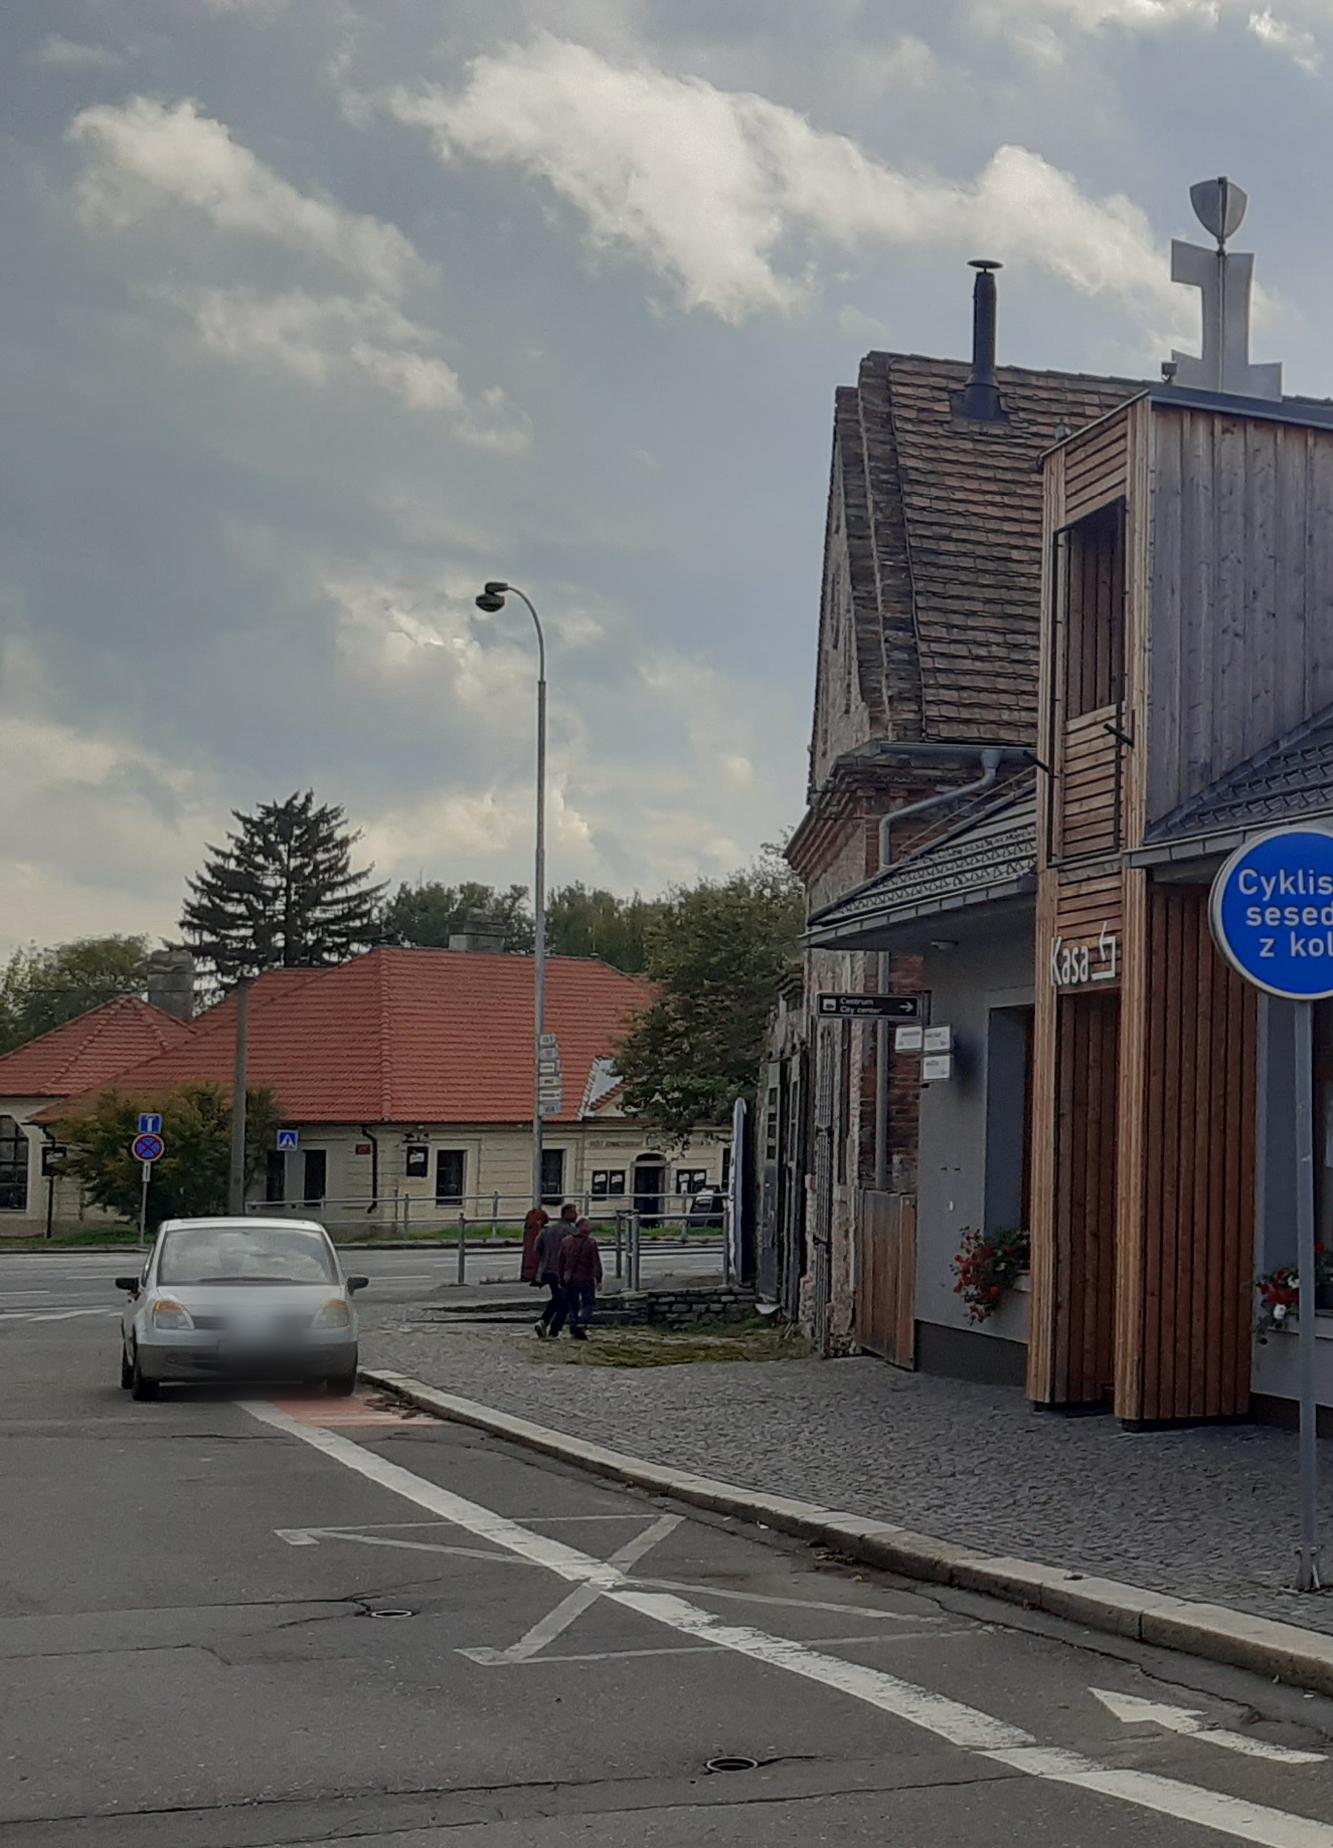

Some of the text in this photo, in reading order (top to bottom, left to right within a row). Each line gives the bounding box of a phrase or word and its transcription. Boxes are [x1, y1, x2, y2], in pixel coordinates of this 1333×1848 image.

[1259, 937, 1275, 958] z
[1050, 935, 1089, 986] Kasa
[840, 997, 875, 1007] Centrum
